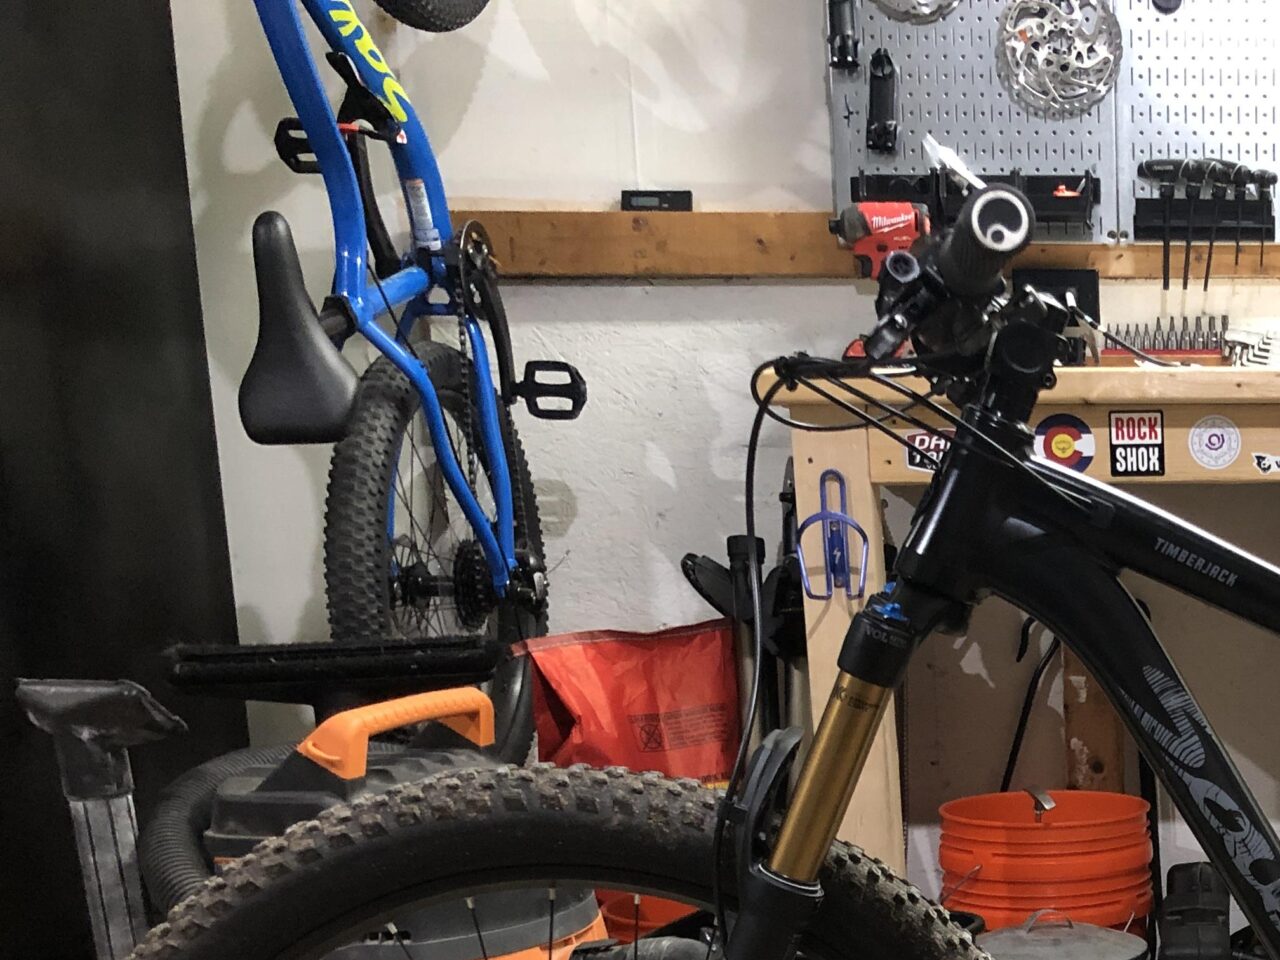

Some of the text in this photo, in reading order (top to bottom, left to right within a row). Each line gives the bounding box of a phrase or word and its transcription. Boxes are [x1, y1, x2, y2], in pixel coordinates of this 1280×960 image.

[1115, 416, 1159, 441] ROCK
[1115, 453, 1160, 473] SHOX
[1154, 536, 1239, 588] TIMBERJACK
